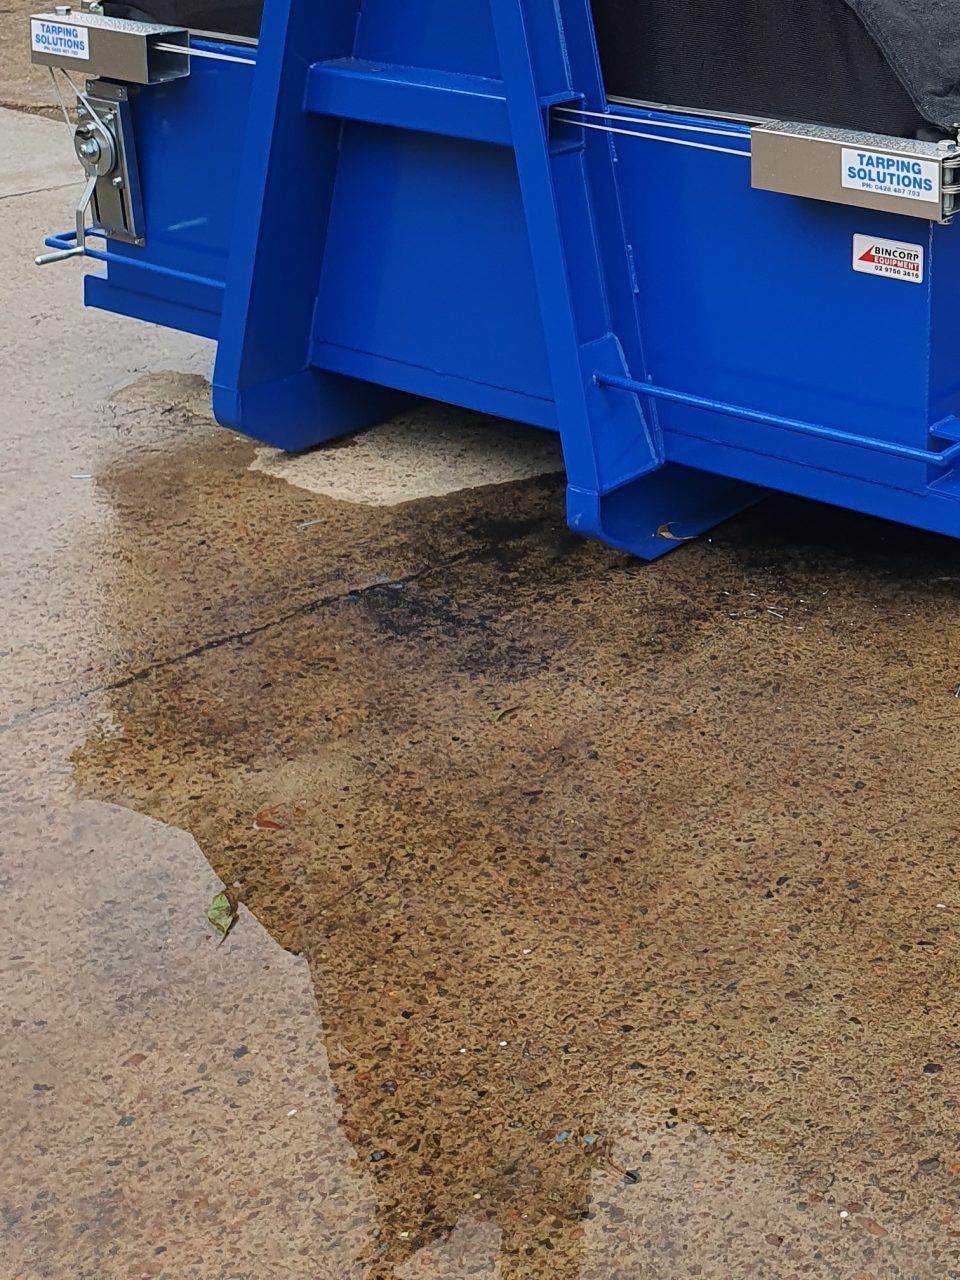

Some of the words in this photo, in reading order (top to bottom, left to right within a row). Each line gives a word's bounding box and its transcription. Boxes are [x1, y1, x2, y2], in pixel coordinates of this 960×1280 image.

[40, 23, 78, 38] TARPING
[35, 33, 85, 51] SOLUTIONS
[857, 153, 922, 175] TARPING
[847, 166, 933, 191] SOLUTIONS
[874, 246, 919, 262] BINCORP
[874, 256, 919, 271] EQUIPMENT
